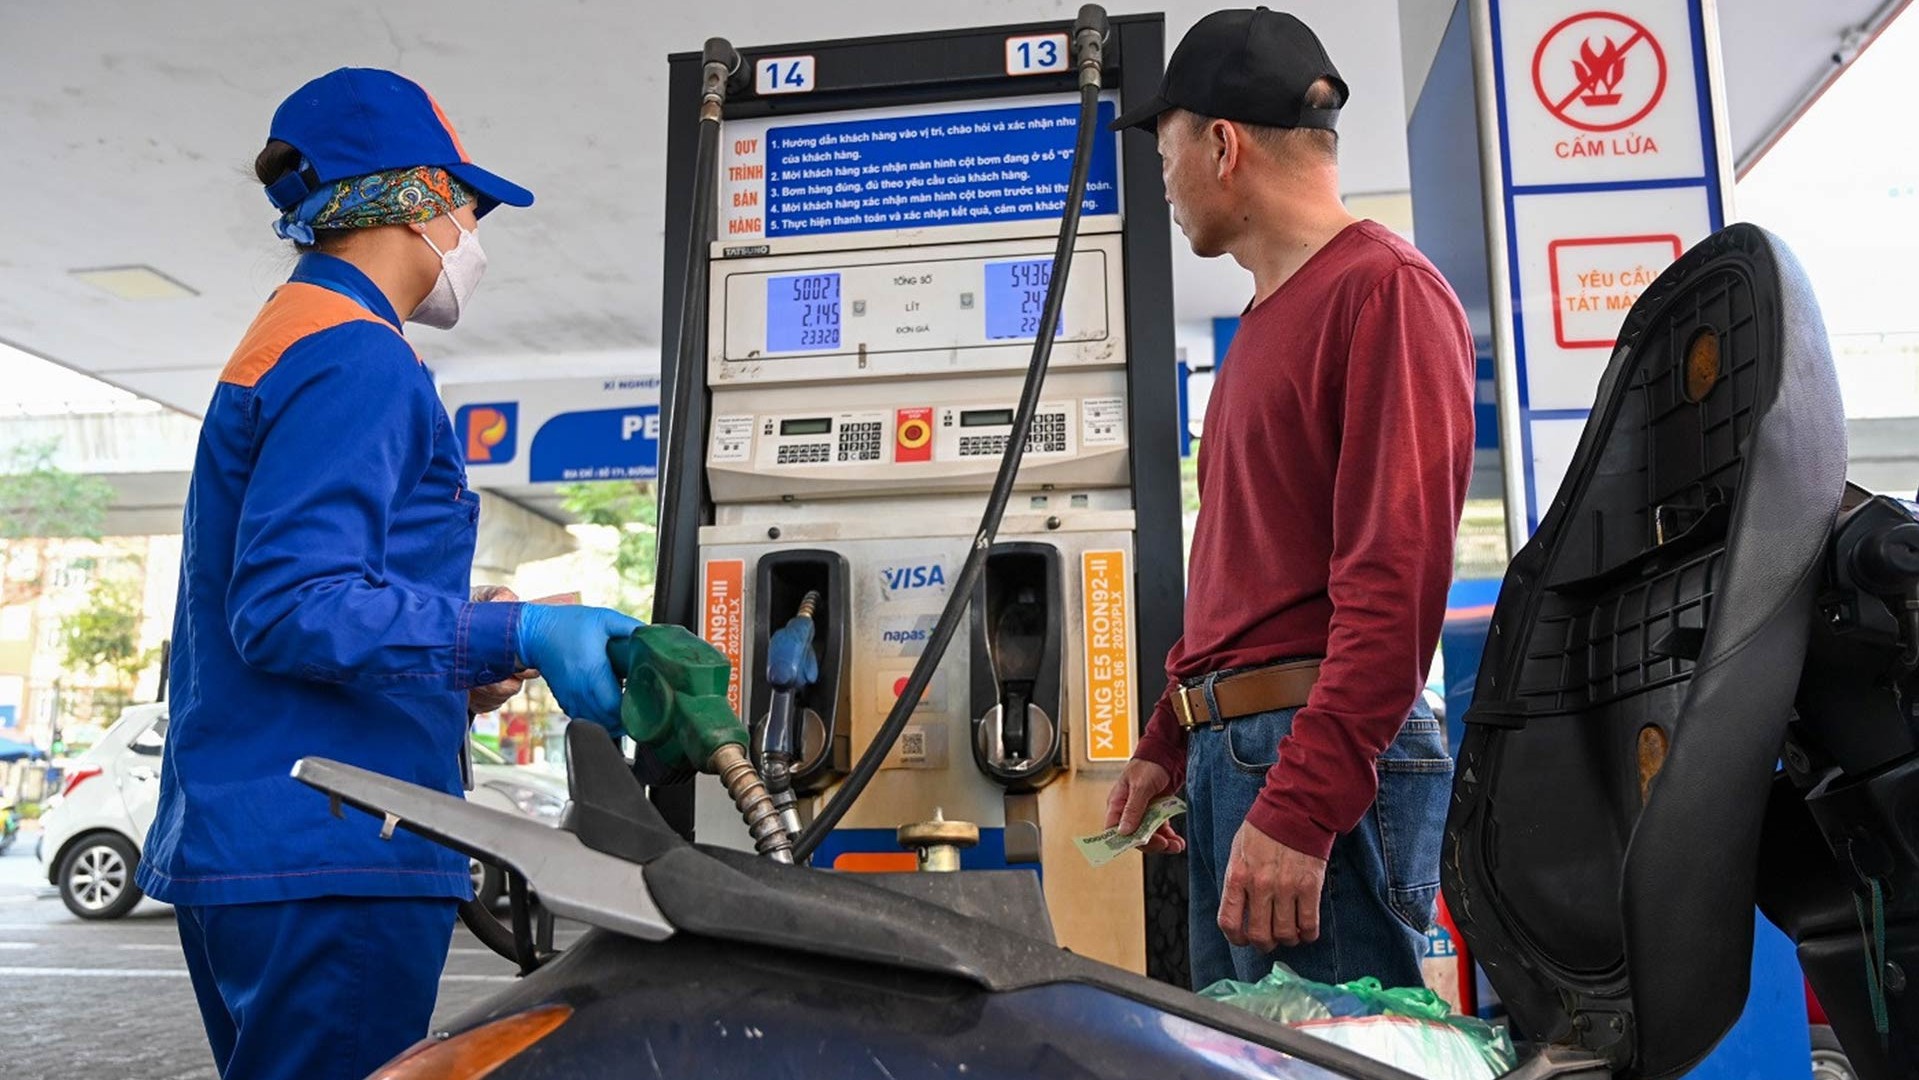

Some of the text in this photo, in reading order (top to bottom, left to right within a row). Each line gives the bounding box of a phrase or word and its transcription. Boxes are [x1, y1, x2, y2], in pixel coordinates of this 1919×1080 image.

[1017, 40, 1058, 69] 13
[766, 62, 804, 88] 14
[782, 137, 817, 149] Hướng
[840, 132, 869, 143] khách
[872, 131, 897, 142] hàng
[899, 129, 917, 138] vào
[947, 125, 972, 134] chào
[993, 121, 1005, 131] và
[1008, 120, 1025, 130] xác
[1028, 118, 1054, 130] nhận
[1056, 117, 1076, 126] nhu
[1555, 132, 1658, 158] CẤM LỬA
[735, 140, 757, 156] QUY
[802, 152, 831, 163] khách
[729, 164, 763, 181] TRÌNH
[782, 171, 800, 180] Mời
[803, 168, 833, 178] khách
[835, 167, 860, 177] hàng
[862, 164, 880, 174] xác
[883, 162, 907, 173] nhận
[909, 160, 931, 170] màn
[958, 157, 975, 168] cột
[977, 156, 1001, 165] bơm
[1003, 154, 1030, 165] đang
[1042, 149, 1055, 161] số
[782, 187, 806, 197] Bơm
[808, 185, 833, 195] hàng
[881, 179, 903, 189] theo
[905, 177, 924, 189] yêu
[968, 172, 999, 182] khách
[734, 189, 757, 207] BÁN
[782, 203, 800, 213] Mời
[803, 200, 833, 211] khách
[835, 199, 860, 209] hàng
[863, 197, 880, 206] xác
[883, 194, 907, 206] nhận
[910, 193, 931, 203] màn
[959, 190, 975, 201] cột
[978, 189, 1001, 198] bơm
[1003, 186, 1033, 196] trước
[1036, 184, 1052, 194] khi
[729, 216, 761, 234] HÀNG
[782, 219, 807, 230] Thực
[810, 217, 831, 228] hiện
[833, 215, 862, 226] thanh
[864, 212, 886, 223] toán
[889, 211, 900, 221] và
[903, 210, 921, 220] xác
[923, 208, 949, 220] nhận
[951, 205, 967, 217] kết
[1018, 204, 1033, 213] ơn
[726, 247, 768, 256] TATSUNO
[894, 274, 932, 286] TỔNG SỐ
[1011, 263, 1049, 287] 5436
[1578, 269, 1614, 288] YÊU
[793, 277, 840, 301] 50021
[1606, 292, 1637, 310] MÁ
[803, 302, 839, 327] 2.145
[905, 302, 920, 312] LÍT
[801, 329, 839, 345] 23320
[882, 565, 945, 590] VISA
[712, 580, 728, 653] ON95-III
[729, 598, 740, 655] 2023/PLX
[1111, 591, 1124, 650] 2023/PLX
[884, 629, 925, 643] napas
[1091, 559, 1114, 750] XĂNG E5 RON92-II
[1114, 660, 1125, 676] 06
[1114, 681, 1126, 716] TCCS
